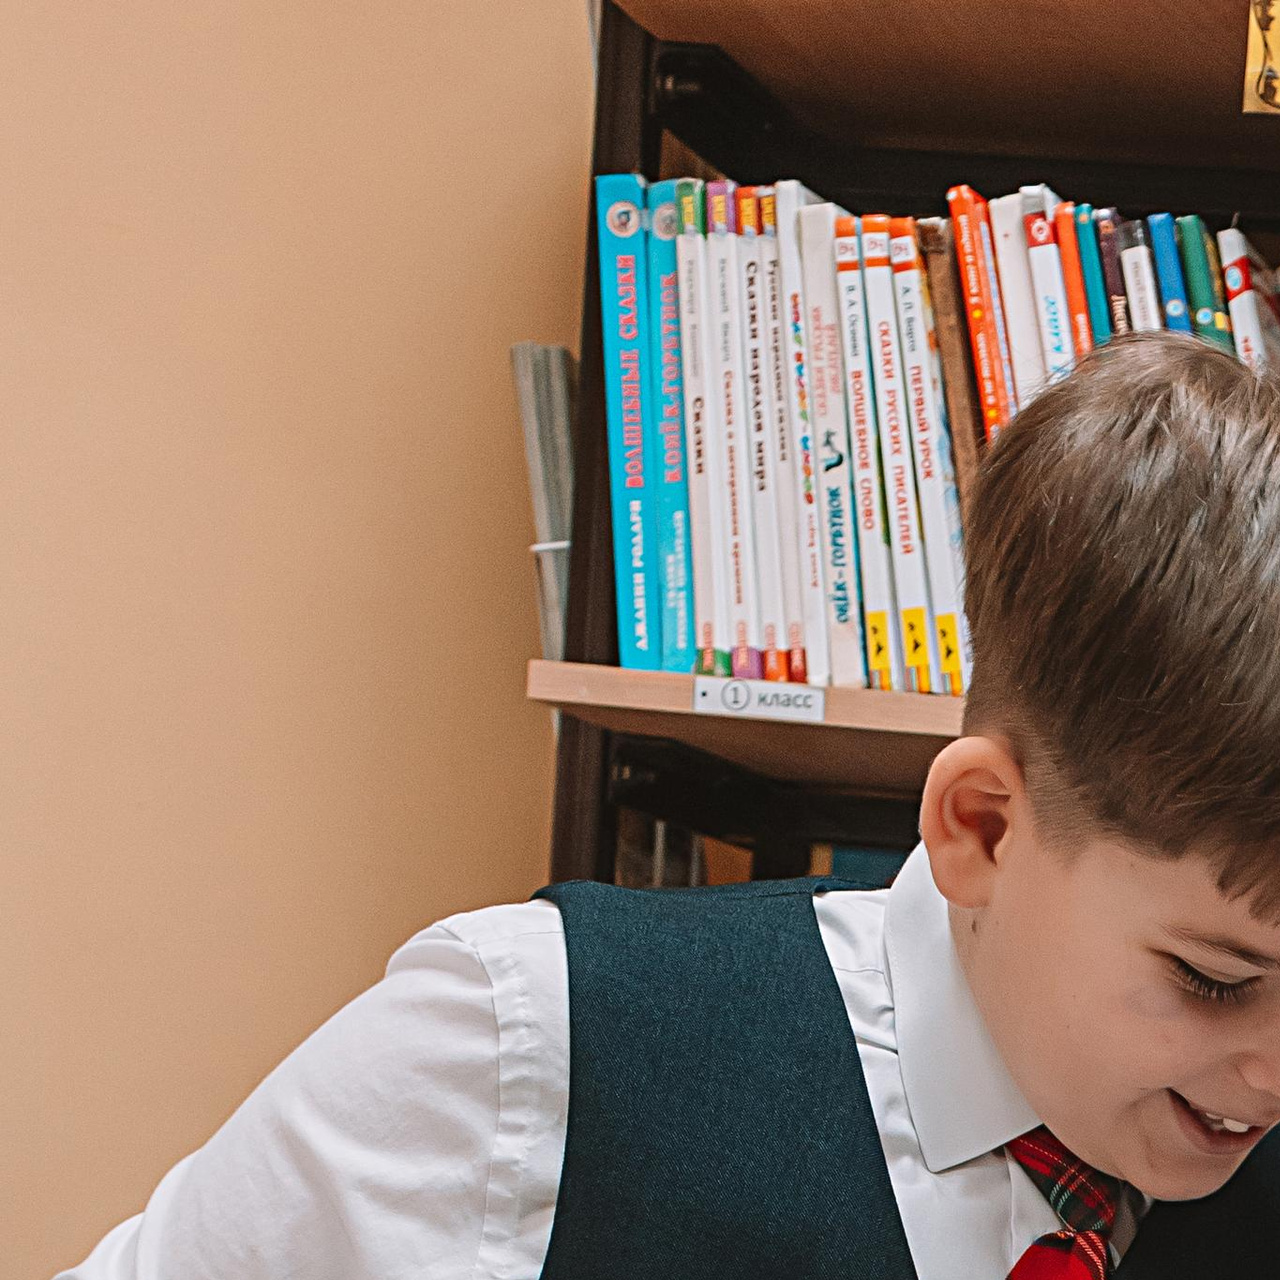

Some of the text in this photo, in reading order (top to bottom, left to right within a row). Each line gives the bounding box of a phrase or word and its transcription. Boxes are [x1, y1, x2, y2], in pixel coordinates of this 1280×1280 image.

[617, 255, 644, 488] ВОЛШЕБНЫЕ СКАЗКИ
[692, 398, 703, 475] Сказки
[746, 261, 766, 491] Сказки народов мира
[851, 371, 876, 530] ВОЛШЕБНОЕ СЛОВО
[878, 322, 913, 555] СКАЗКИ РУССКИХ ПИСАТЕЛЕЙ
[909, 366, 935, 479] ПЕРВЫЙ УРОК
[757, 691, 813, 709] класс
